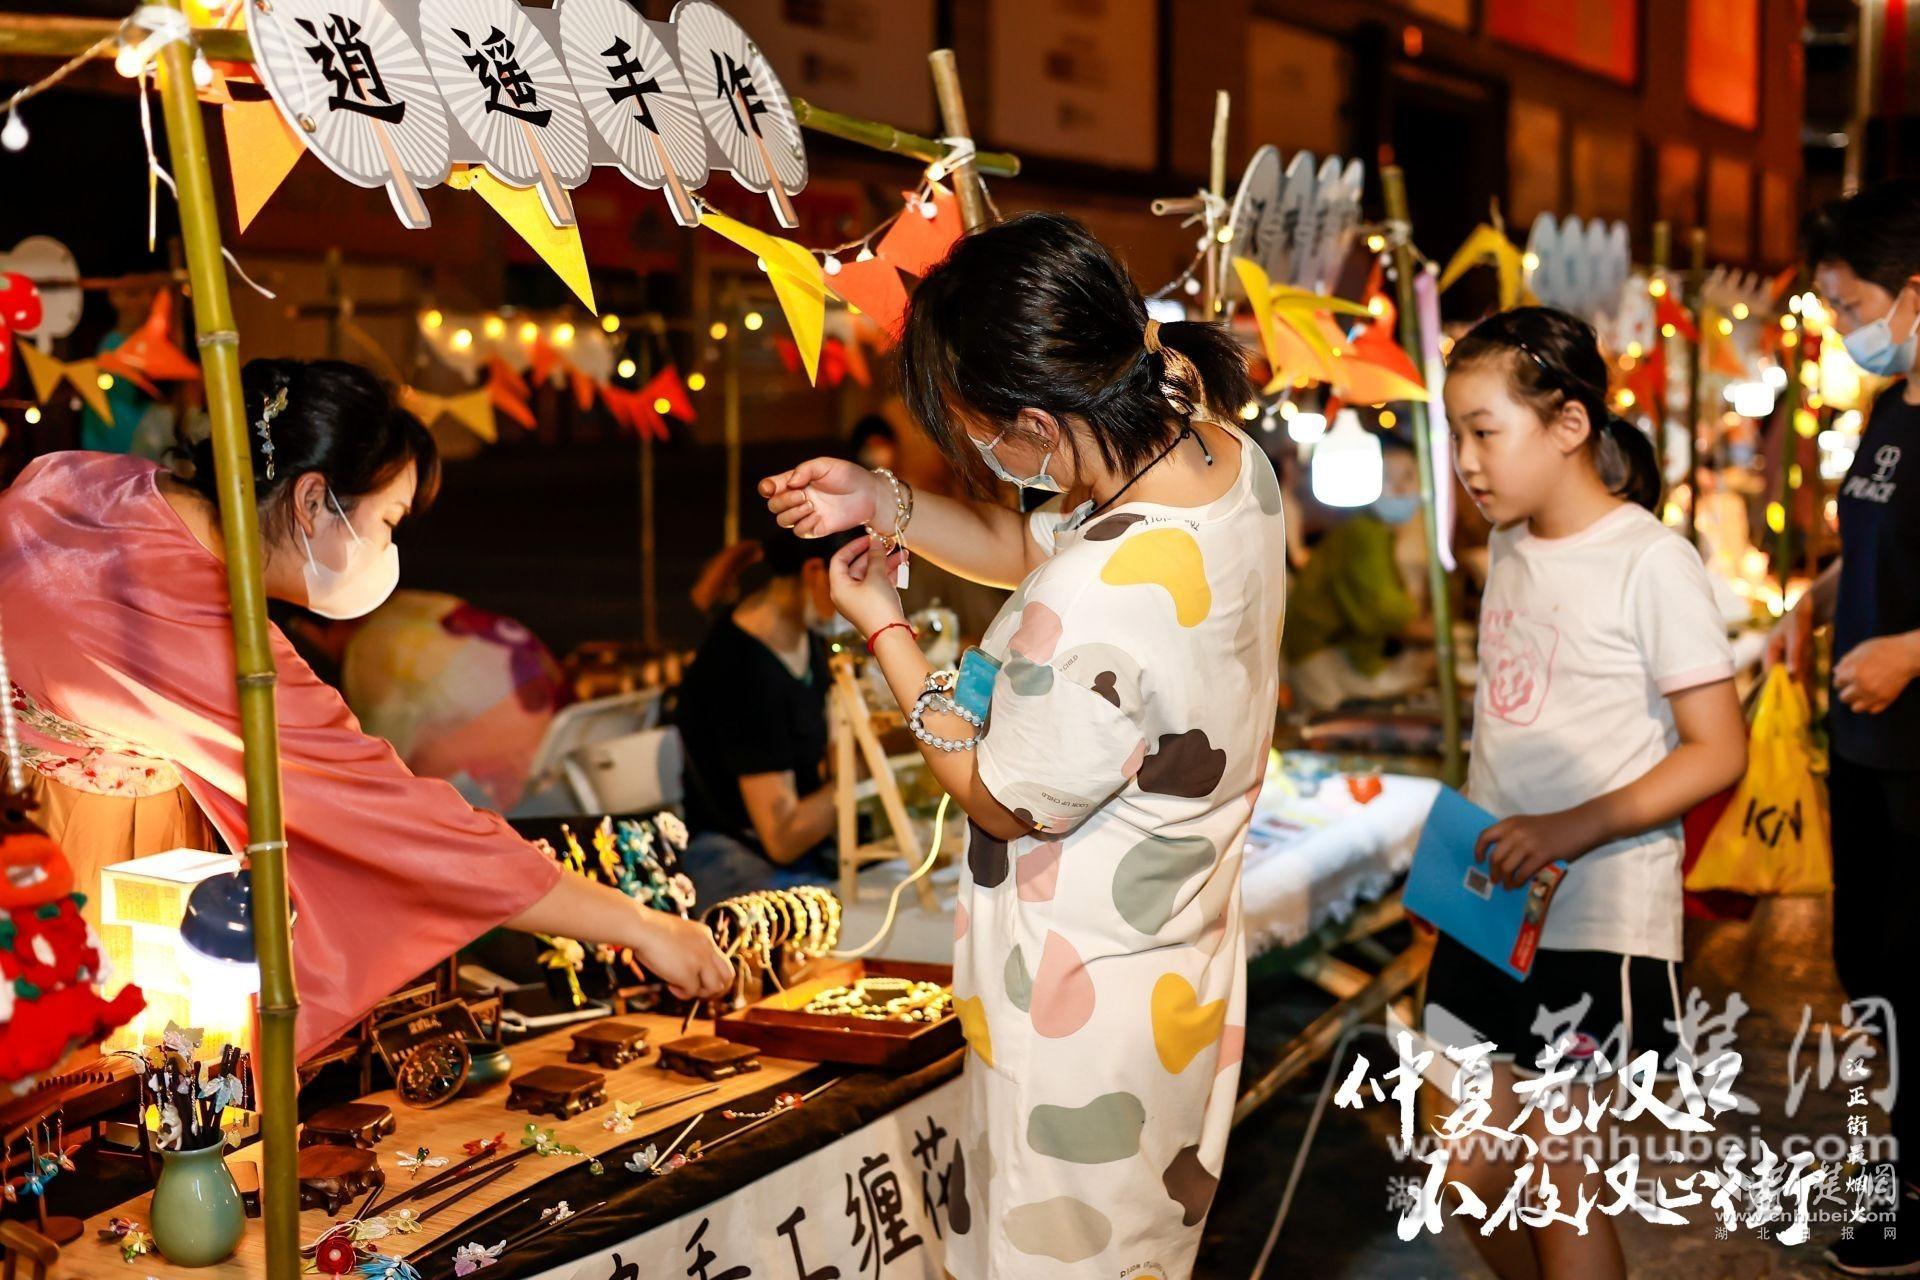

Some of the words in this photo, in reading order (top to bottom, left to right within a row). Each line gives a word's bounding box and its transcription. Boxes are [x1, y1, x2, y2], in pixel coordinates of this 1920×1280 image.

[294, 12, 768, 140] 逍遥手作
[1041, 791, 1061, 804] CHILD
[1071, 801, 1089, 809] LOOK
